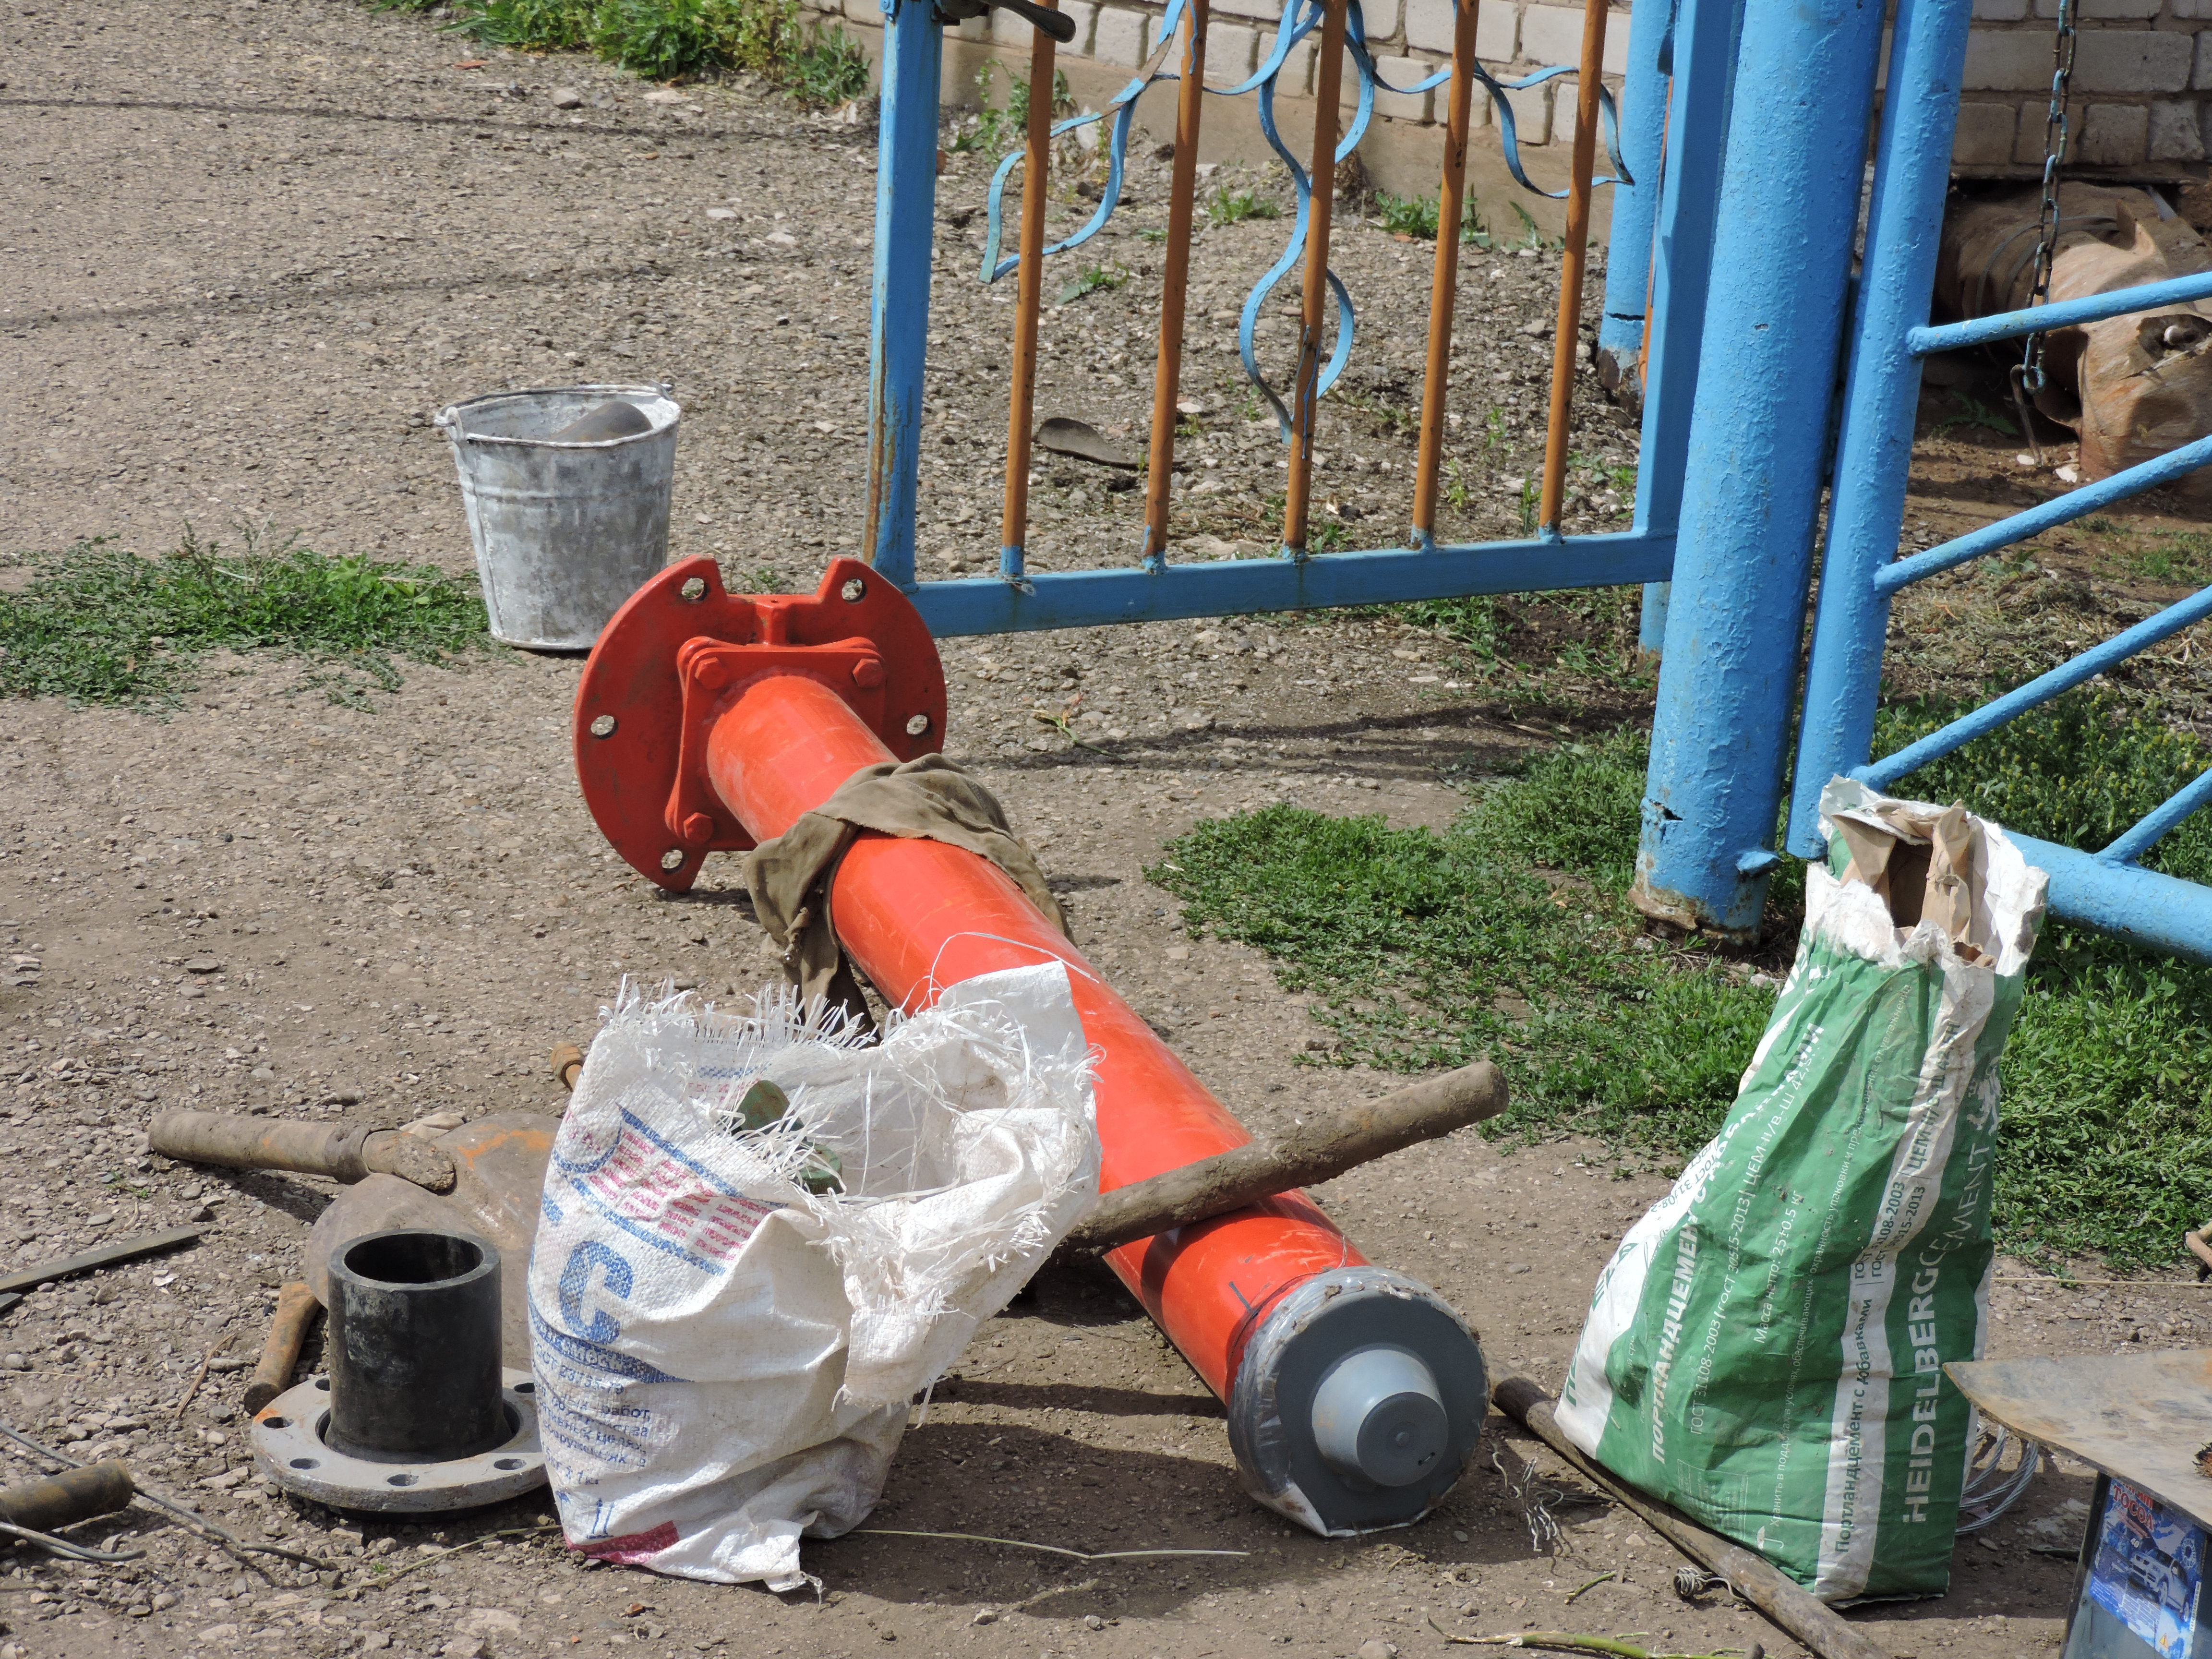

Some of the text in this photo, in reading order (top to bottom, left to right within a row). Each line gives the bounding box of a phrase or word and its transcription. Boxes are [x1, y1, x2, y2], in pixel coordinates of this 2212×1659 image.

[1743, 1148, 1767, 1186] ЦЕМ
[1907, 1128, 1931, 1169] ЦЕМ
[1728, 1198, 1750, 1274] 30515-2013
[1718, 1274, 1736, 1312] ГОСТ
[1753, 1190, 1805, 1345] Масса нетто: 25±0.5 кг
[1770, 1485, 1783, 1527] Хранить
[1794, 1281, 1814, 1367] обеспечивающих
[1810, 1216, 1833, 1280] охранность
[1828, 1161, 1851, 1213] упаковки
[1874, 1054, 1884, 1069] от
[1695, 1321, 1720, 1397] 31108-2003
[1691, 1398, 1705, 1435] ГОСТ
[1835, 1298, 1872, 1553] Портландцемент с добавками
[2113, 1485, 2154, 1531] ТОСОЛ
